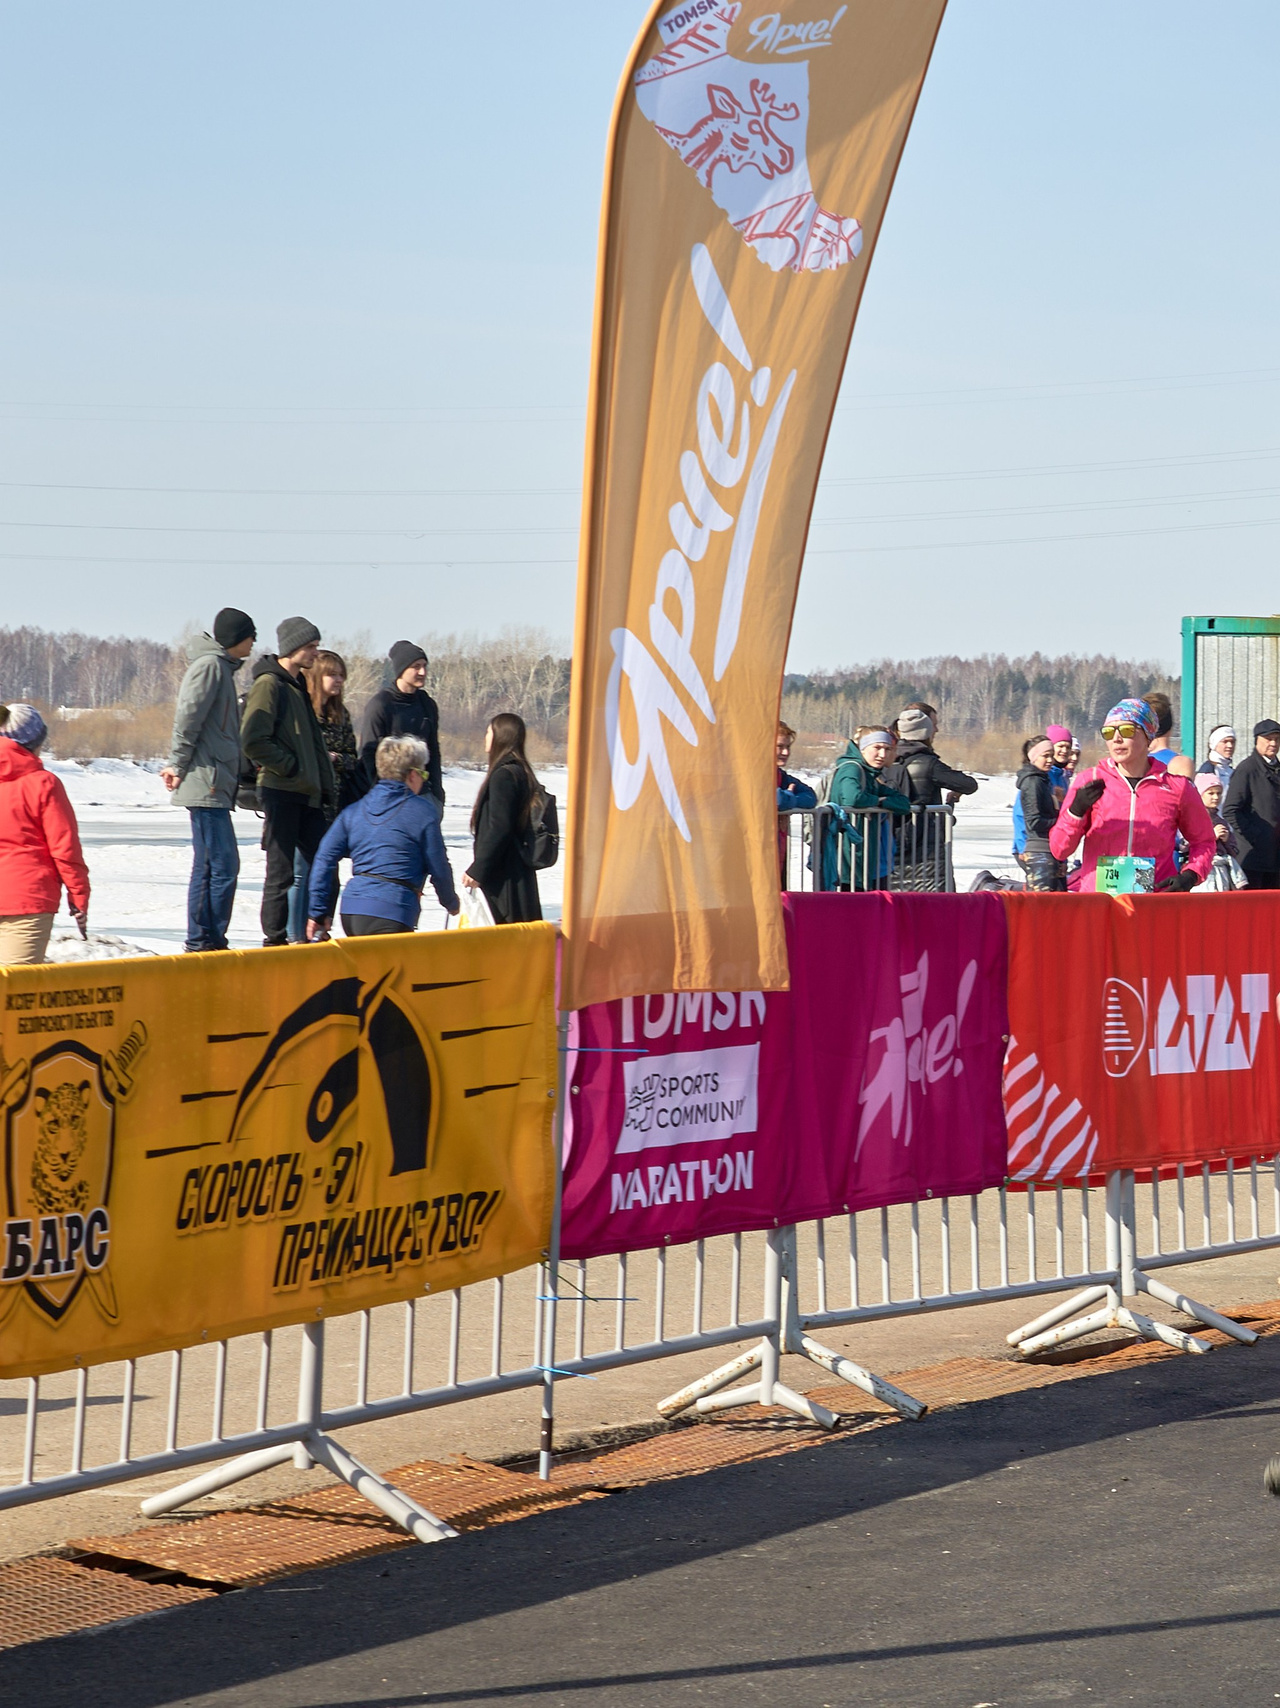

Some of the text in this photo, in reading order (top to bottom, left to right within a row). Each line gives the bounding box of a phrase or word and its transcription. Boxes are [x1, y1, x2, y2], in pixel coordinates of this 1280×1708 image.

[746, 4, 848, 55] Ярче!
[605, 242, 798, 842] Ярче!
[1105, 868, 1119, 880] 734
[659, 1072, 720, 1098] SPORTS
[177, 1152, 304, 1230] СКОРОСТЬ
[2, 1207, 109, 1282] БАРС
